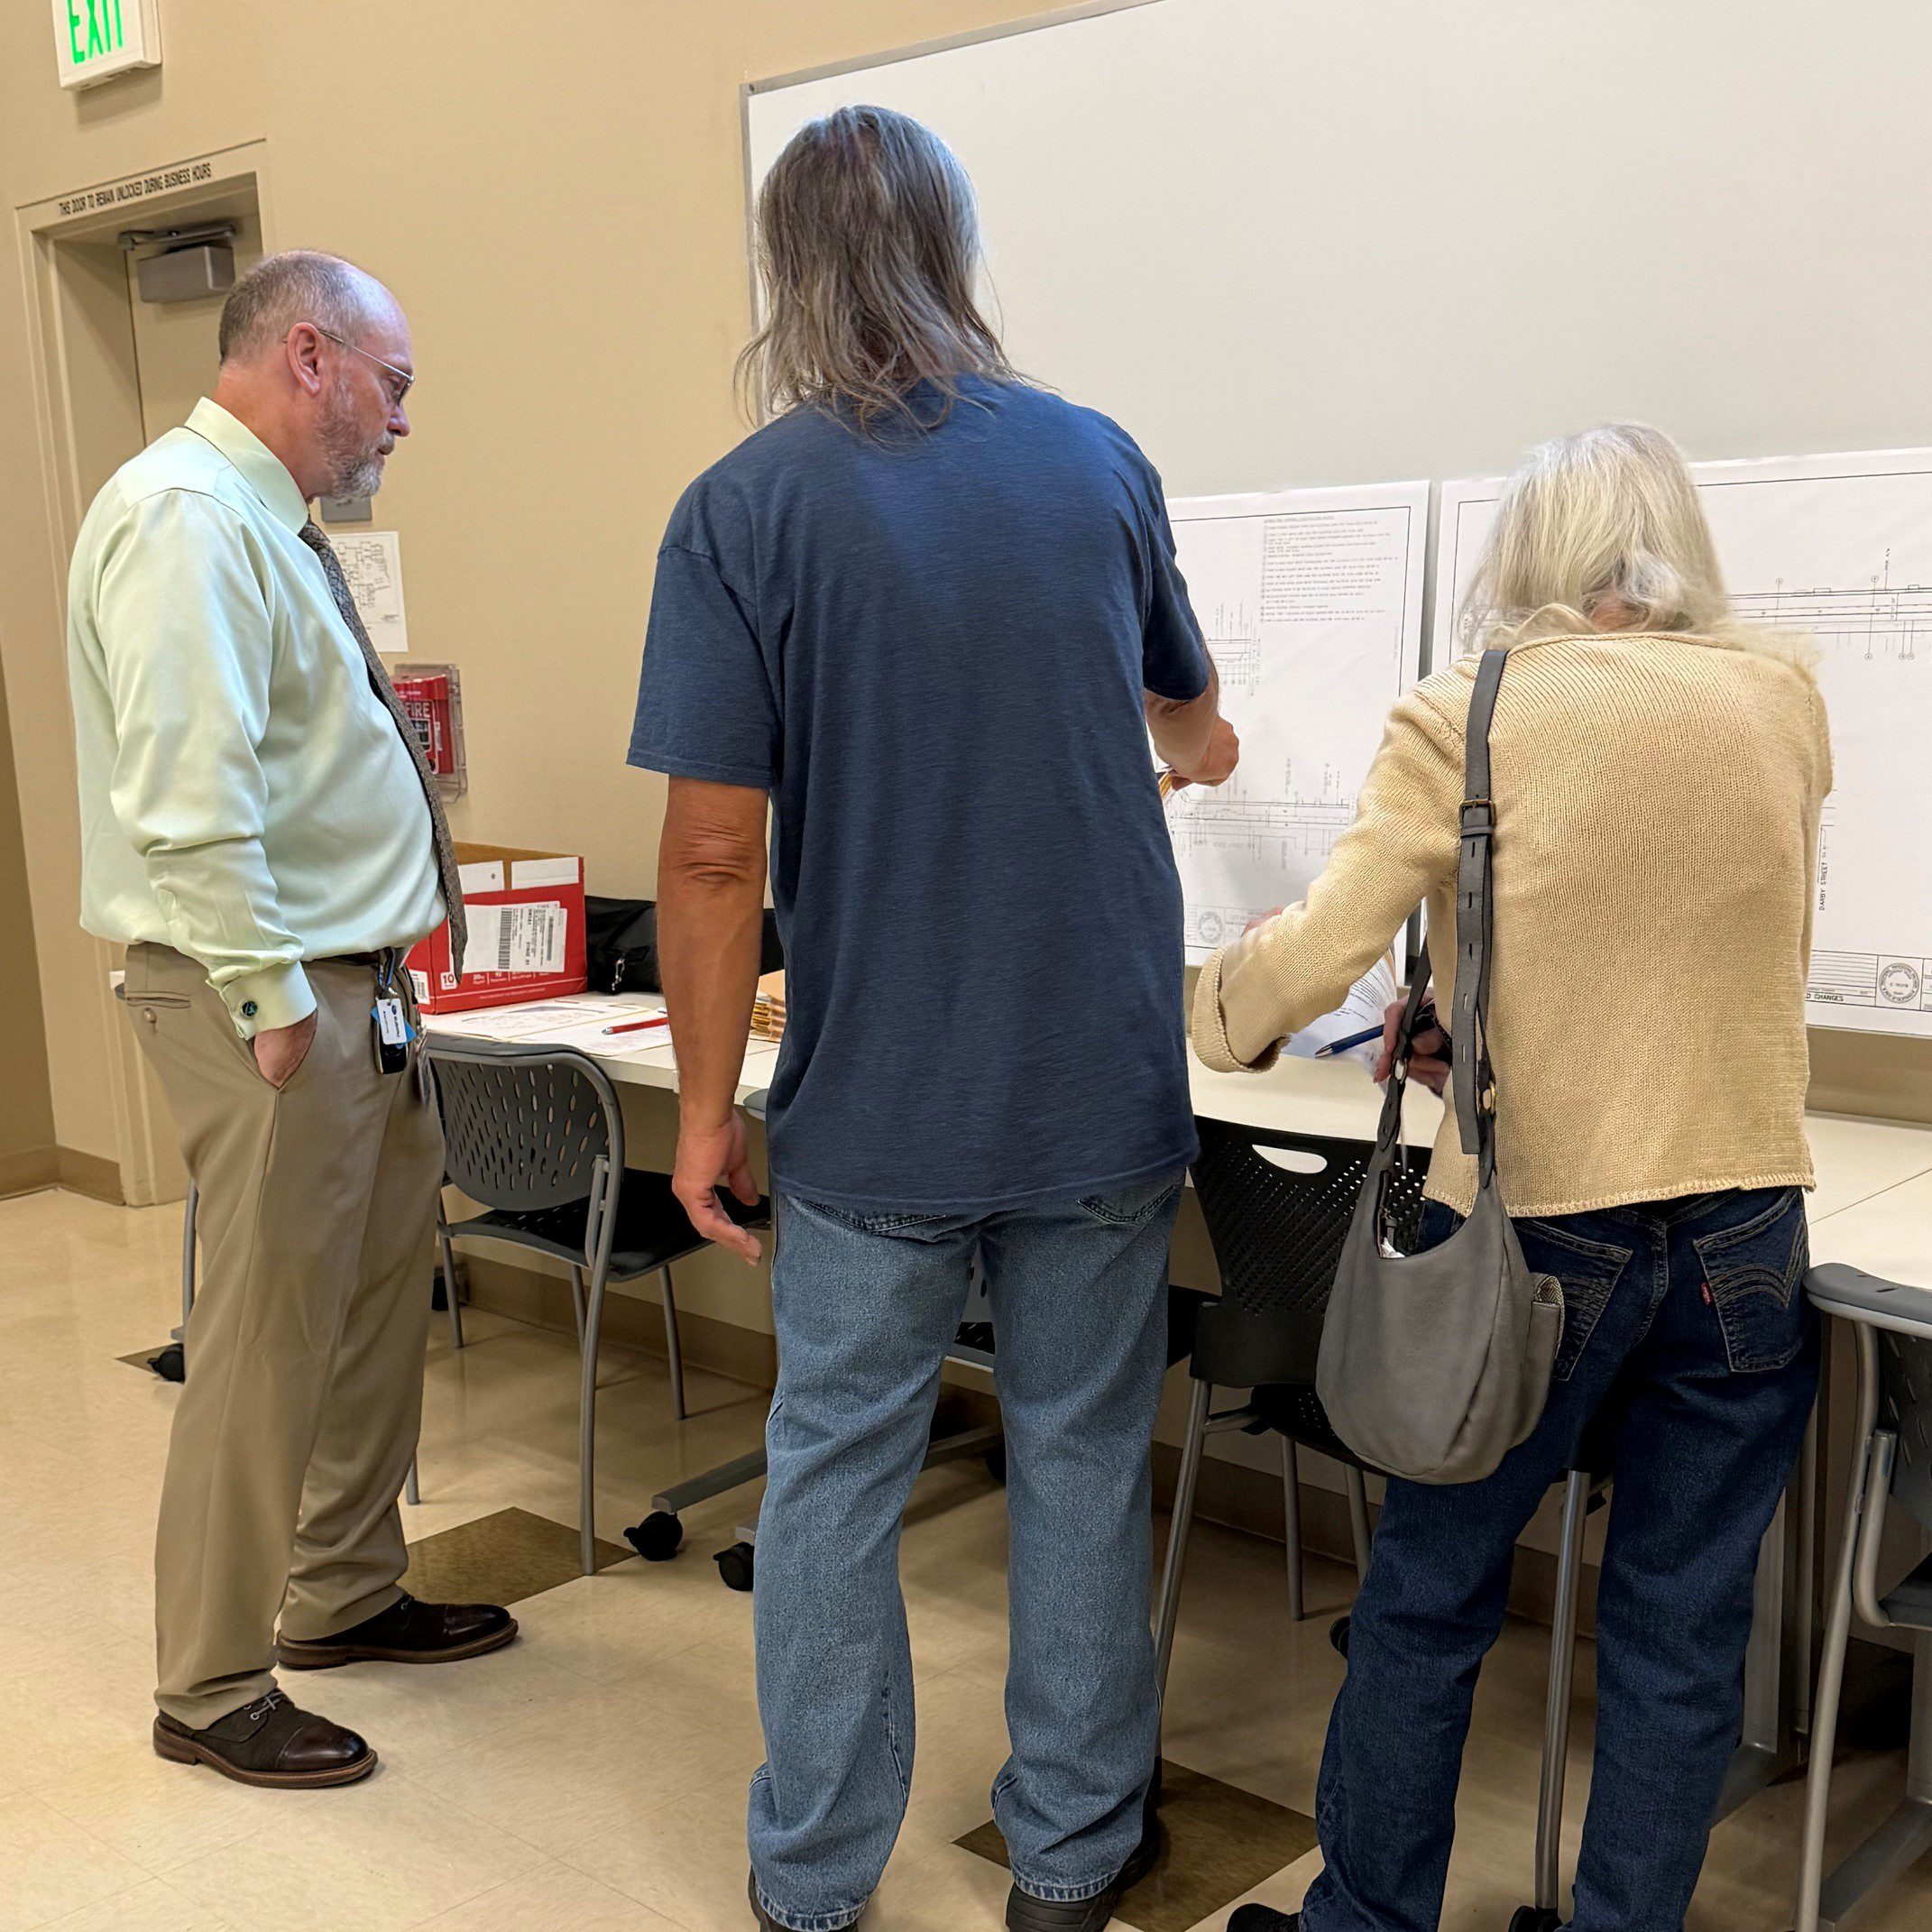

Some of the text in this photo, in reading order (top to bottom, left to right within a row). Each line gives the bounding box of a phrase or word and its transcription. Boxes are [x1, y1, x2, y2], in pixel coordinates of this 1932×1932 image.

[59, 162, 212, 215] THIS DOOR TO REMAIN UNLOCKED DURING BUSINESS HOURS
[405, 702, 430, 718] FIRE
[443, 973, 455, 984] 10
[1814, 993, 1845, 1002] CHANGES
